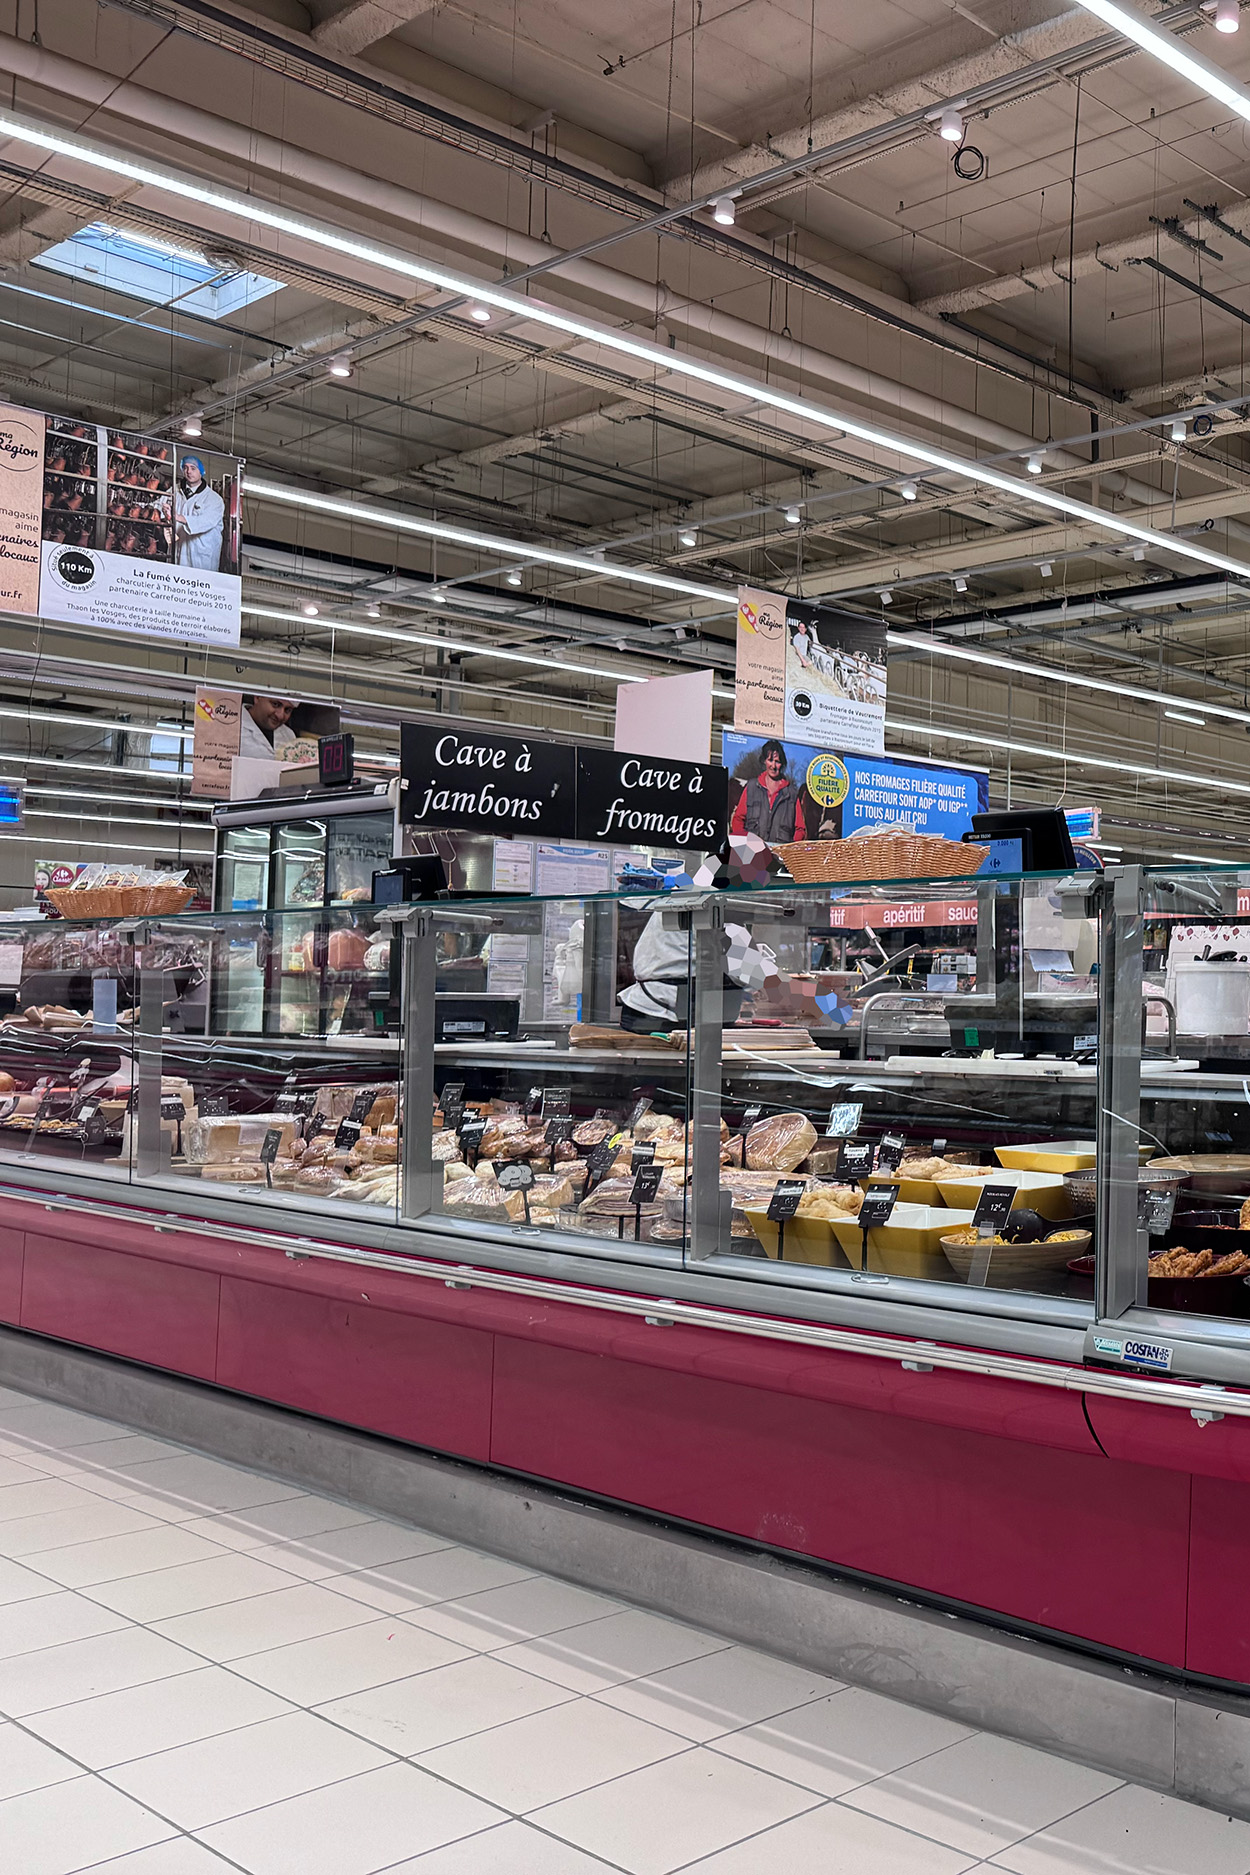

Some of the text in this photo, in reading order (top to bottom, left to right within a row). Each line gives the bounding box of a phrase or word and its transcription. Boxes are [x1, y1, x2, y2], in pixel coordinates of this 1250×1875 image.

[0, 438, 39, 459] Région
[15, 521, 39, 533] aime
[0, 545, 39, 564] locaux
[61, 562, 93, 574] 110 Km
[116, 577, 155, 590] charcutier
[162, 584, 186, 595] Thaon
[187, 587, 198, 596] les
[199, 589, 227, 602] Vosges
[133, 568, 211, 590] La fumé Vosgien
[109, 585, 233, 611] partenaire Carrefour depuis 2010
[67, 603, 231, 635] Thaon les Vosges, des produits de terroir élaborés
[94, 599, 109, 608] Une
[109, 602, 148, 614] charcuterie
[154, 609, 171, 618] taille
[172, 612, 201, 622] humaine
[97, 616, 116, 624] 100%
[117, 620, 132, 628] avec
[134, 621, 146, 630] des
[147, 624, 173, 634] viandes
[173, 627, 208, 639] françaises.
[758, 616, 783, 631] Région
[748, 662, 764, 671] votre
[746, 679, 784, 693] partenaires
[744, 719, 776, 729] carrefour.fr
[434, 735, 533, 773] Cave à
[620, 760, 704, 794] Cave à
[818, 778, 839, 787] FILIÈRE
[855, 771, 966, 799] NOS FROMAGES FILIÈRE QUALITÉ
[414, 779, 543, 820] jambons
[815, 784, 841, 794] QUALITÉ
[854, 788, 898, 805] CARREFOUR
[899, 794, 918, 808] SONT
[937, 801, 948, 812] OU
[597, 798, 717, 844] fromages
[854, 804, 864, 817] ET
[865, 805, 884, 820] TOUS
[884, 808, 895, 821] AU
[912, 812, 928, 825] CRU
[883, 905, 926, 925] apéritif
[948, 904, 978, 922] sauc
[1125, 1341, 1160, 1359] COSTAN
